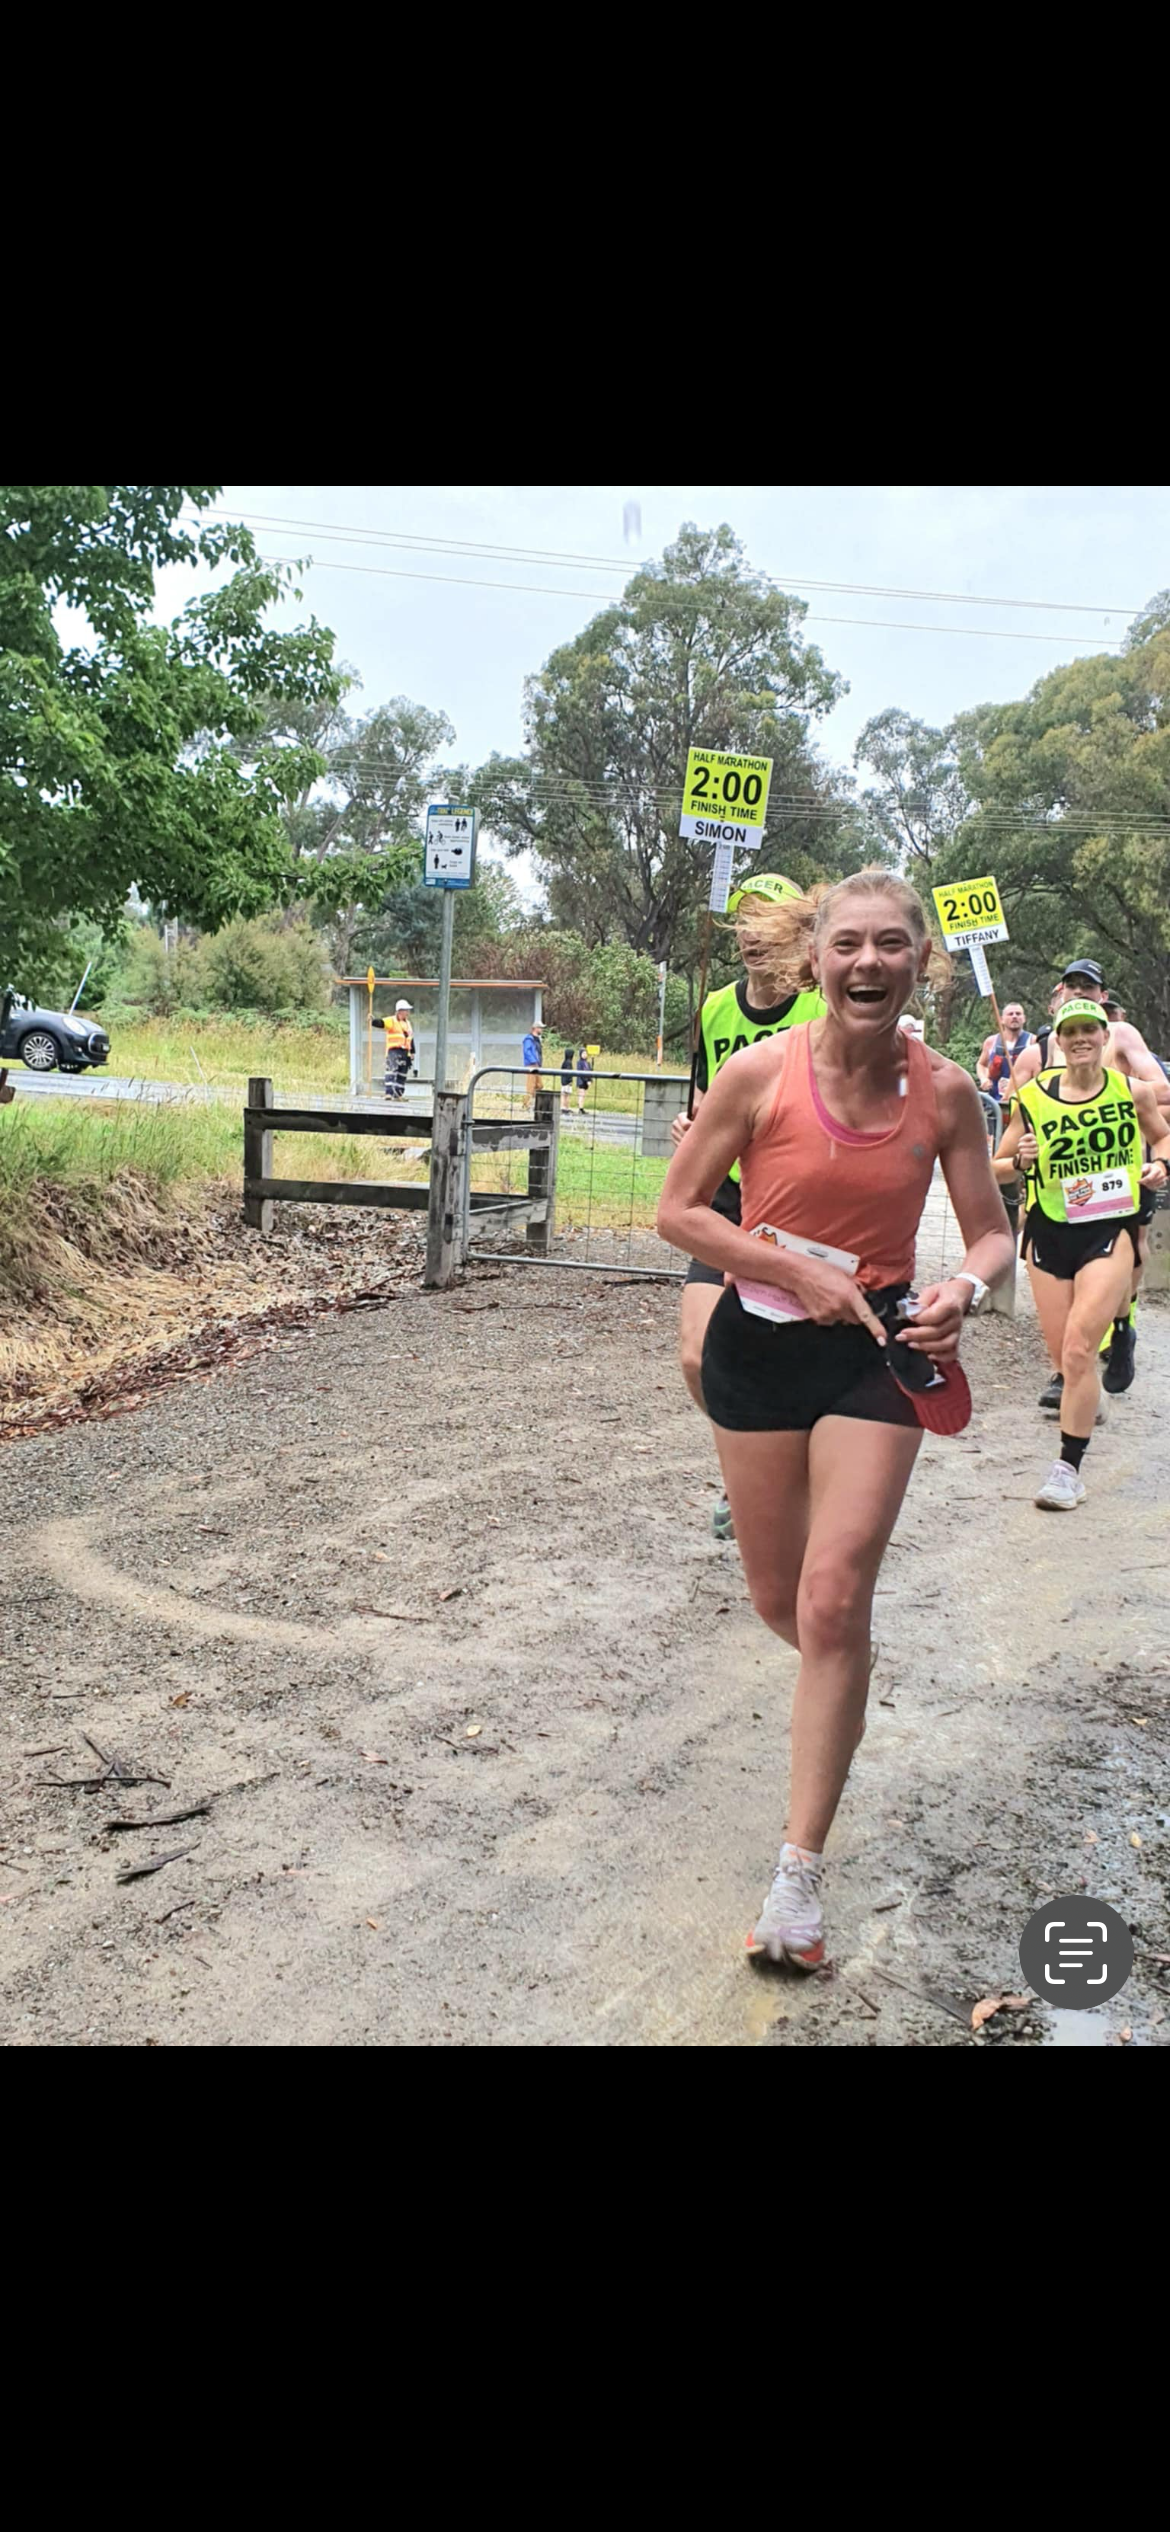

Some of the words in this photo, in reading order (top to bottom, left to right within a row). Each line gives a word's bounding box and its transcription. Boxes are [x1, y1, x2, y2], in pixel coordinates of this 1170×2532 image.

[694, 752, 715, 764] HALF
[717, 755, 767, 771] MARATHON
[691, 766, 762, 805] 2:00
[690, 800, 726, 816] FINISH
[730, 807, 758, 820] TIME
[695, 821, 747, 843] SIMON
[938, 888, 956, 897] HALF
[957, 881, 993, 893] MARATHON
[943, 891, 997, 921] 2:00
[949, 918, 978, 931] FINISH
[980, 913, 999, 924] TIME
[954, 929, 999, 946] TIFFANY
[1061, 1002, 1097, 1015] PACER
[1041, 1101, 1136, 1141] PACER
[1049, 1121, 1135, 1161] 2:00
[1049, 1155, 1102, 1179] FINISH
[1102, 1179, 1123, 1192] 879
